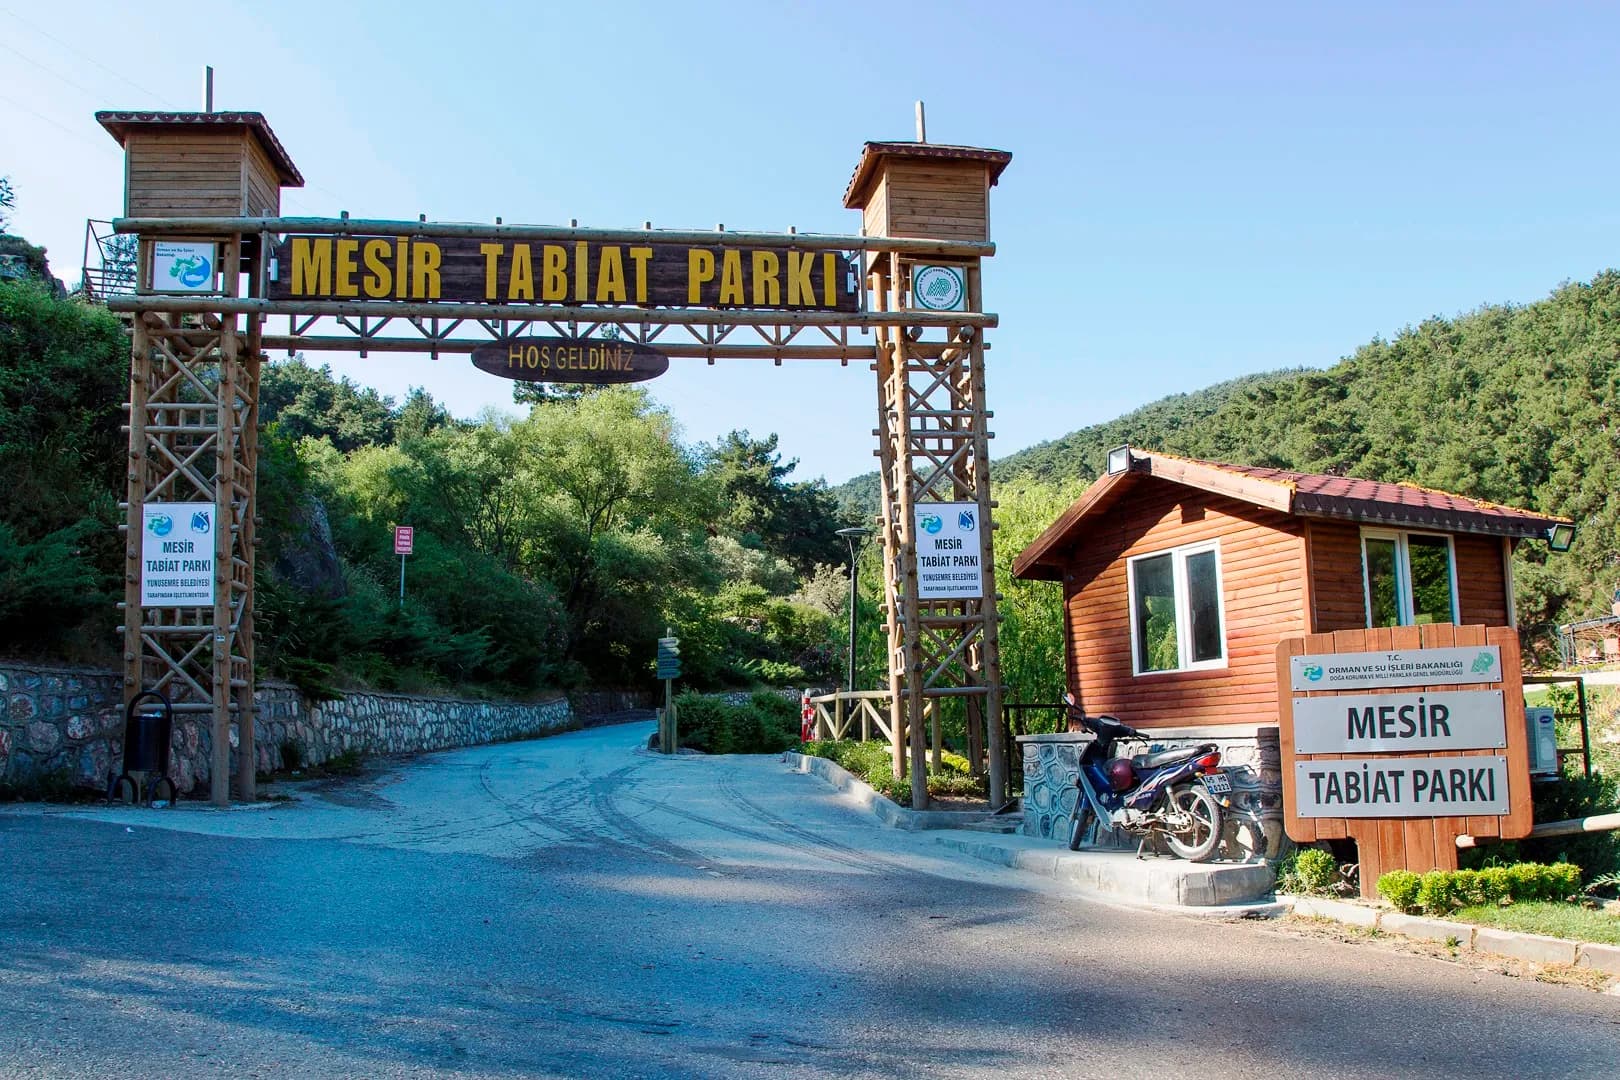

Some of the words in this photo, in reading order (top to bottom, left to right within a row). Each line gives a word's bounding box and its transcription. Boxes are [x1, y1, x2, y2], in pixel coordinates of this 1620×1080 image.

[290, 236, 442, 299] MESİR
[480, 240, 654, 303] TABİAT
[688, 248, 837, 307] PARKI
[508, 344, 551, 375] HOŞ
[555, 342, 635, 372] GELDİNİZ
[163, 539, 194, 553] MESİR
[935, 536, 963, 550] MESİR
[146, 558, 181, 572] TABİAT
[182, 560, 211, 572] PARKI
[921, 554, 951, 567] TABİAT
[953, 555, 978, 567] PARKI
[1387, 654, 1402, 662] T.C.
[1328, 666, 1361, 674] ORMAN
[1388, 662, 1414, 673] İŞLERİ
[1415, 660, 1463, 670] BAKANLIĞI
[1347, 696, 1451, 740] MESİR
[1308, 762, 1405, 805] TABİAT
[1413, 767, 1495, 803] PARKI
